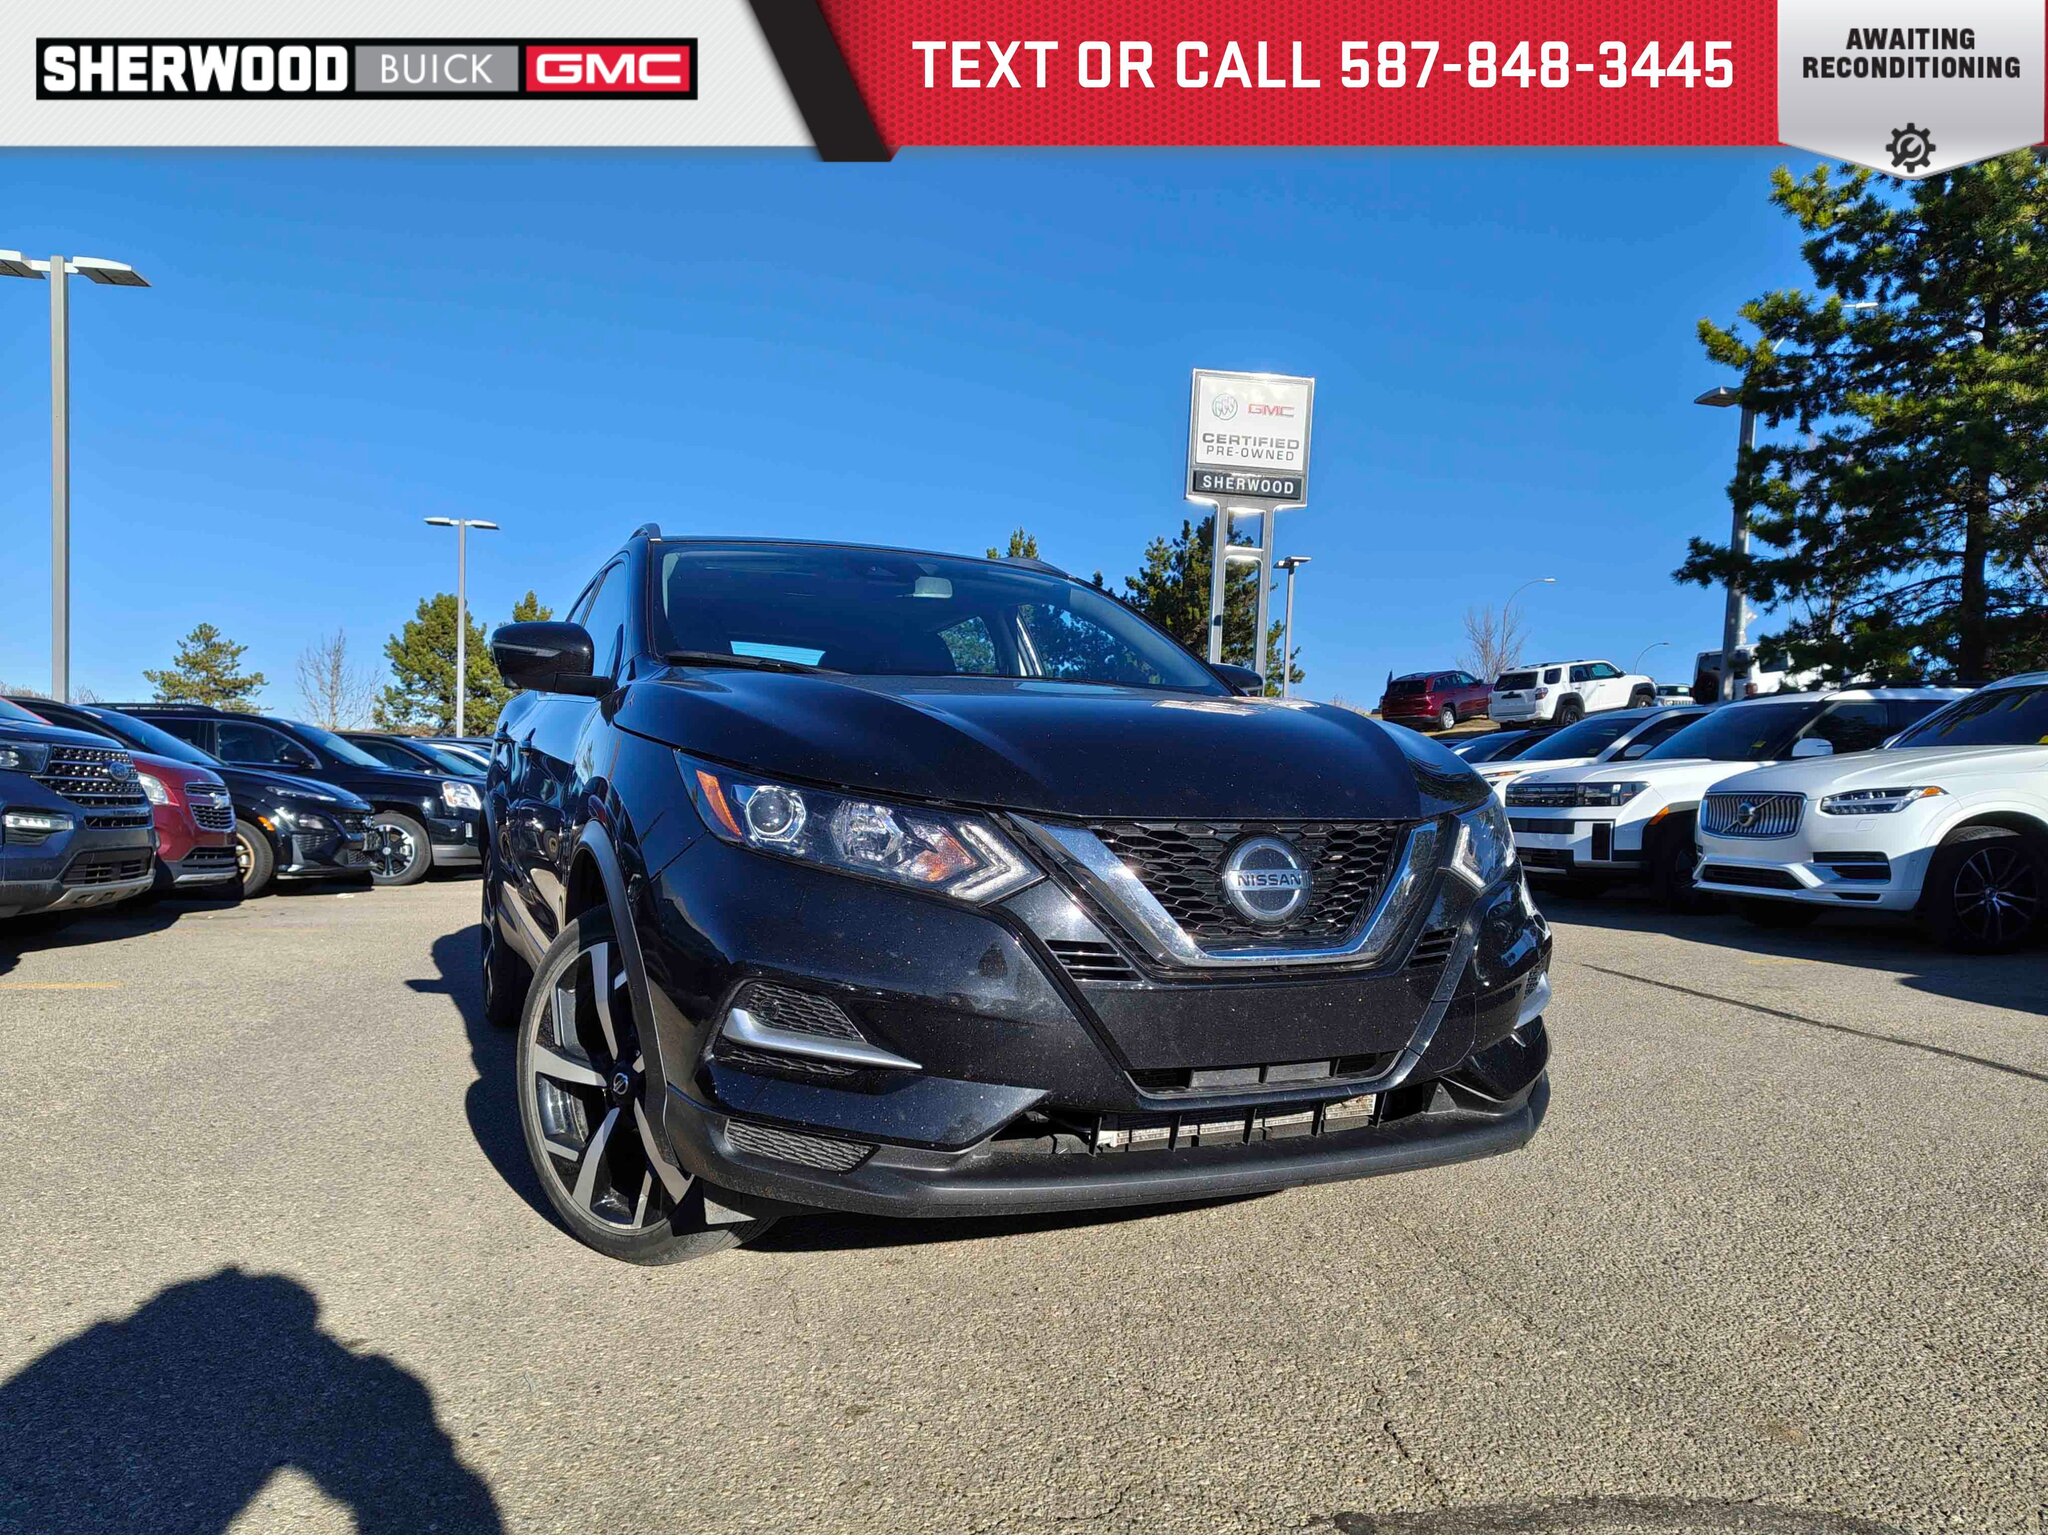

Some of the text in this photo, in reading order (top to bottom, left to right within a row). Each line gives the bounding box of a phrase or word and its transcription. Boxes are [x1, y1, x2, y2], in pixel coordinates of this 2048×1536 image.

[1248, 403, 1295, 418] GMC
[1202, 433, 1300, 450] CERTIFIED
[1206, 445, 1294, 461] PRE-OWNED
[1202, 474, 1294, 494] SHERWOOD
[1237, 873, 1302, 887] NISSAN
